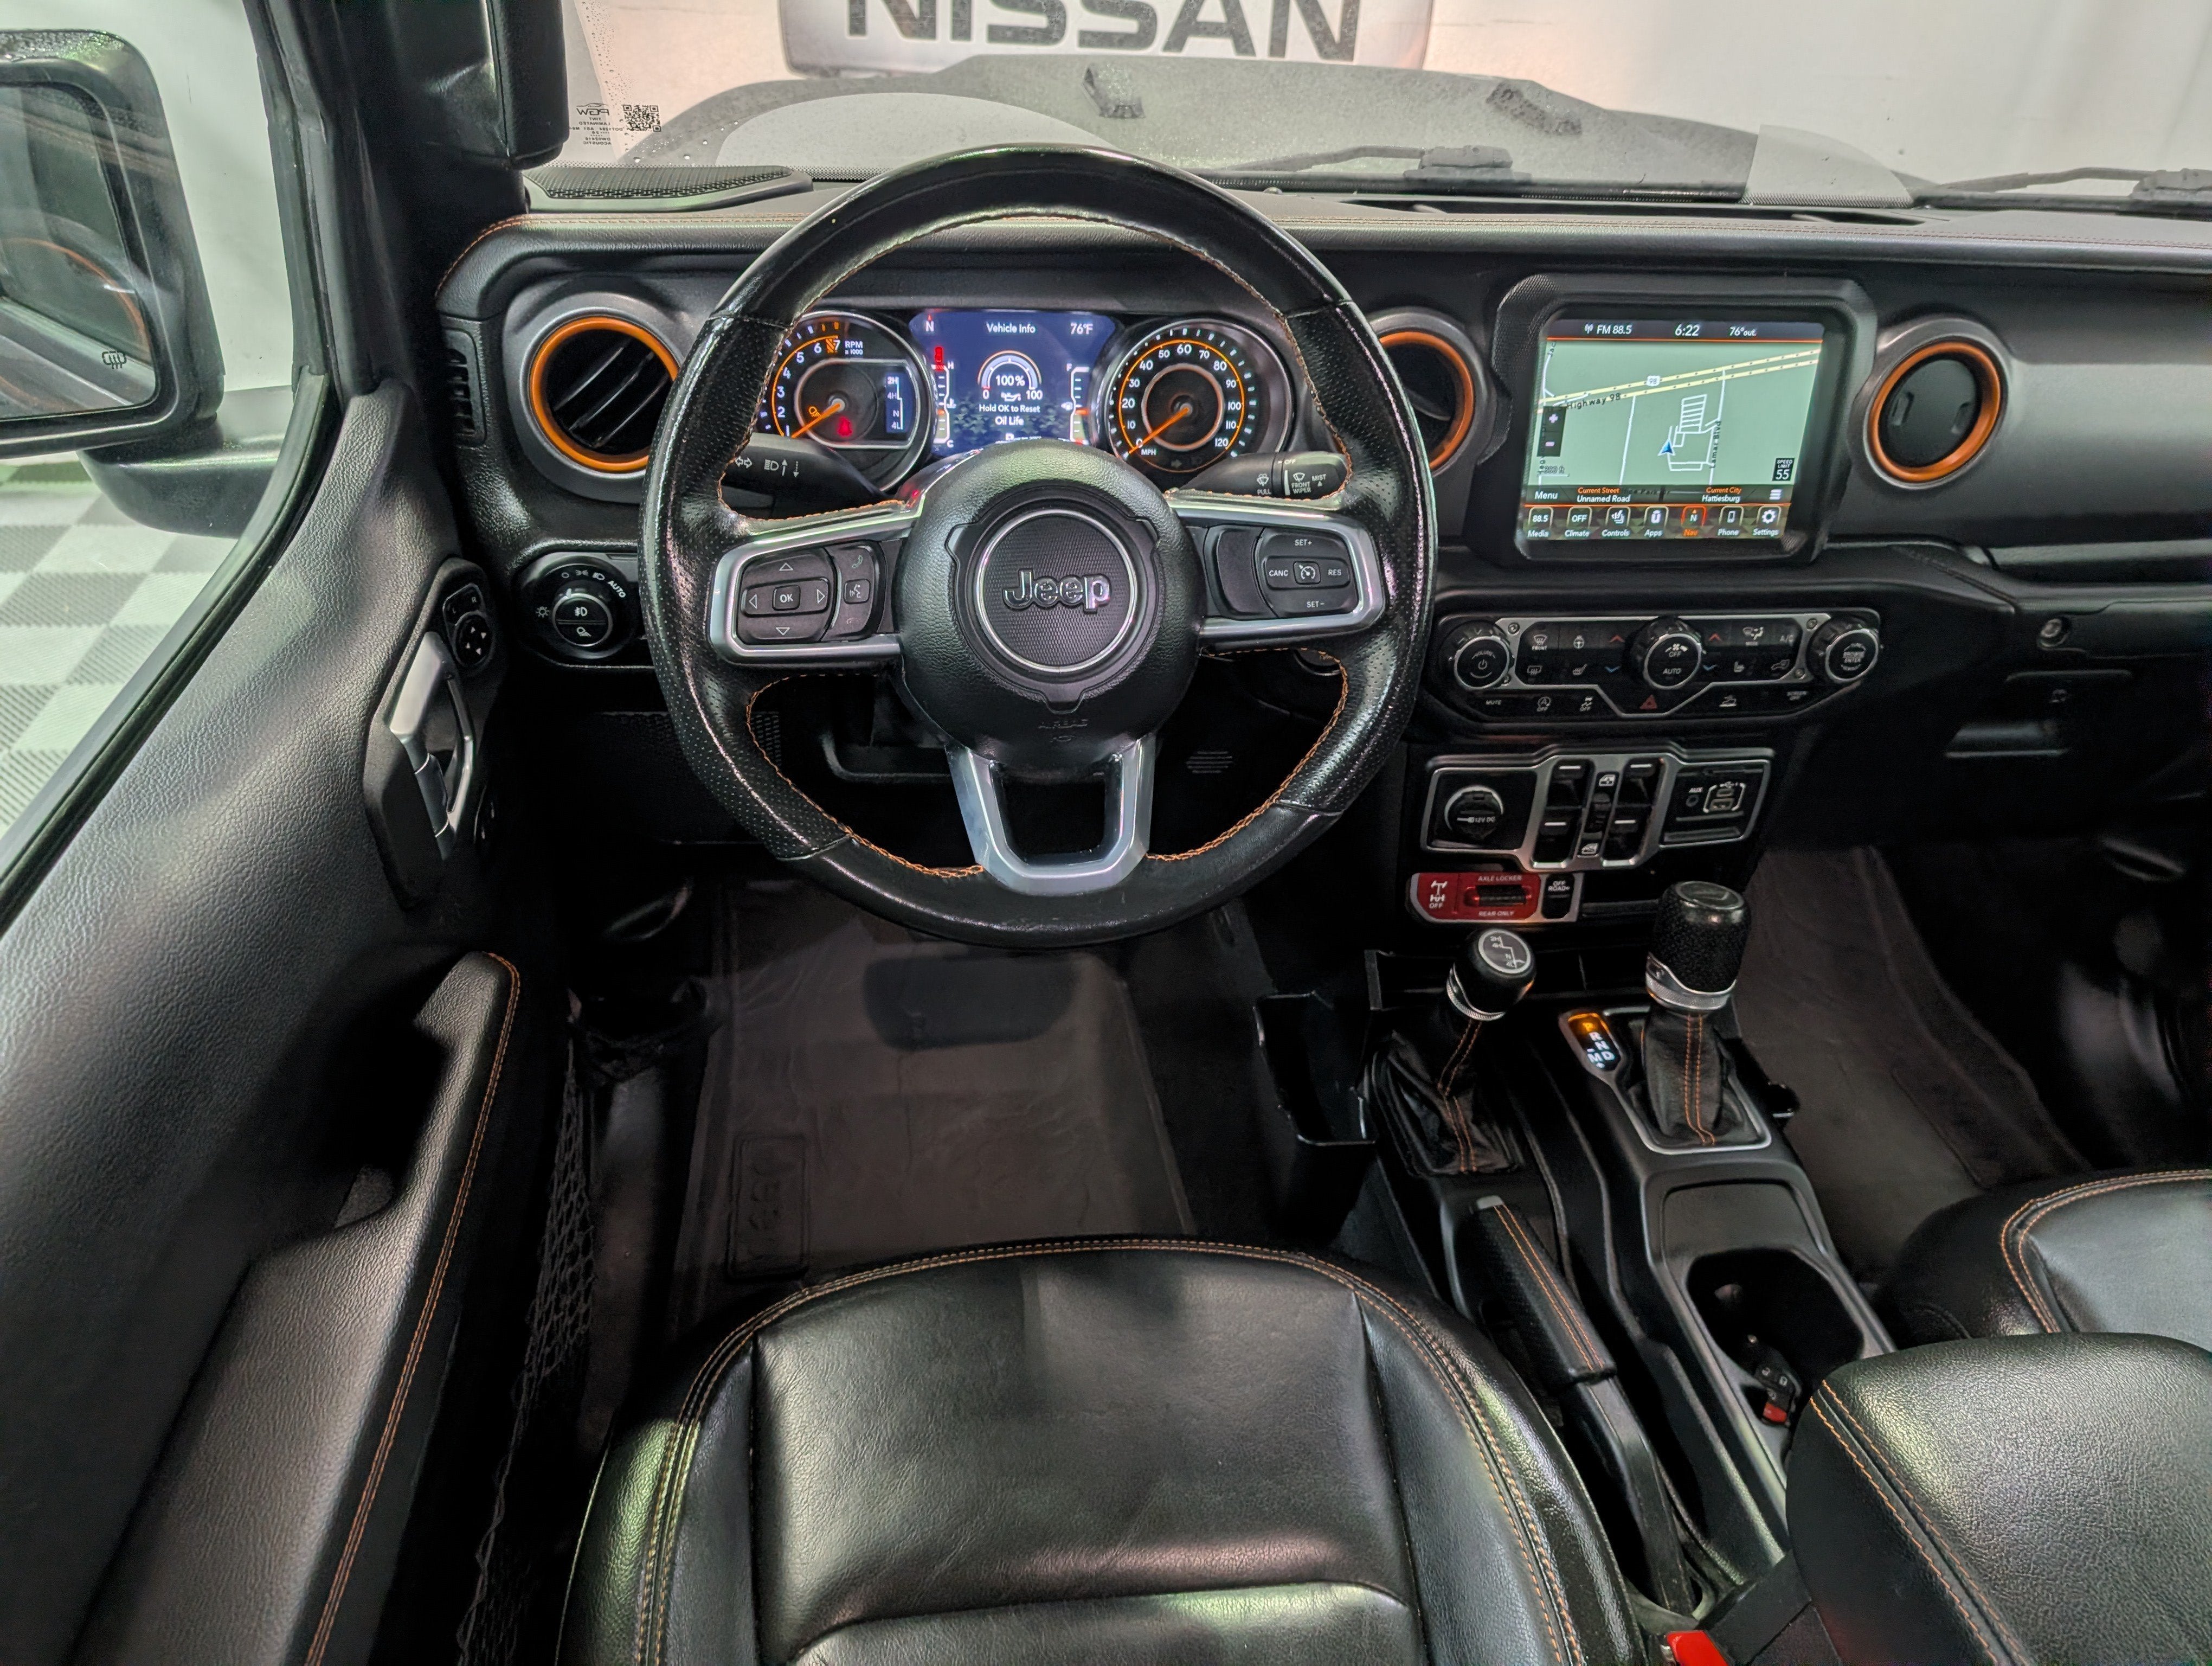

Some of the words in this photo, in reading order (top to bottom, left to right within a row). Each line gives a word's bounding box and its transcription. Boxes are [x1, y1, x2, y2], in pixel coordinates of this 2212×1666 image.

[925, 321, 934, 332] N
[986, 323, 1017, 334] Vehicle
[1019, 323, 1036, 334] Info
[1596, 326, 1611, 335] FM
[1612, 325, 1632, 335] 88.5
[1675, 323, 1701, 336] 6:22
[814, 344, 822, 354] 6
[833, 339, 840, 351] 7
[845, 341, 863, 349] RPM
[1176, 344, 1192, 354] 60
[796, 351, 805, 363] 5
[1158, 350, 1170, 359] 50
[1199, 350, 1210, 360] 70
[948, 362, 954, 370] H
[1139, 360, 1154, 370] 40
[1213, 360, 1227, 371] 80
[783, 367, 791, 379] 4
[887, 376, 899, 385] 2H
[1129, 379, 1140, 388] 30
[1225, 379, 1236, 388] 90
[777, 386, 785, 398] 3
[888, 392, 897, 400] 4H
[982, 390, 989, 400] 0
[1026, 389, 1043, 400] 100
[1122, 398, 1135, 408] 20
[1227, 401, 1242, 411] 100
[1566, 396, 1607, 410] Highway
[1610, 393, 1622, 401] 98
[777, 406, 786, 418] 2
[979, 404, 996, 413] Hold
[998, 405, 1009, 413] OK
[1011, 405, 1019, 413] to
[1020, 405, 1040, 413] Reset
[995, 416, 1007, 425] Oil
[1008, 416, 1024, 426] Life
[1127, 420, 1136, 430] 10
[1225, 421, 1236, 430] 110
[1713, 420, 1721, 439] Blvd
[947, 440, 954, 448] C
[1214, 438, 1229, 447] 120
[1776, 469, 1790, 479] 55
[1535, 491, 1558, 499] Menu
[1701, 495, 1741, 503] Hattiesburg
[1533, 514, 1548, 522] 88.5
[1527, 530, 1549, 538] Media
[1565, 529, 1590, 537] Climate
[1644, 529, 1662, 537] Apps
[1752, 528, 1779, 536] Settings
[607, 580, 626, 598] AUTO
[1003, 568, 1111, 613] Jeep
[780, 593, 794, 603] OK
[1582, 1022, 1594, 1031] P
[1589, 1031, 1603, 1041] R
[1594, 1040, 1610, 1050] N
[1601, 1051, 1616, 1061] D
